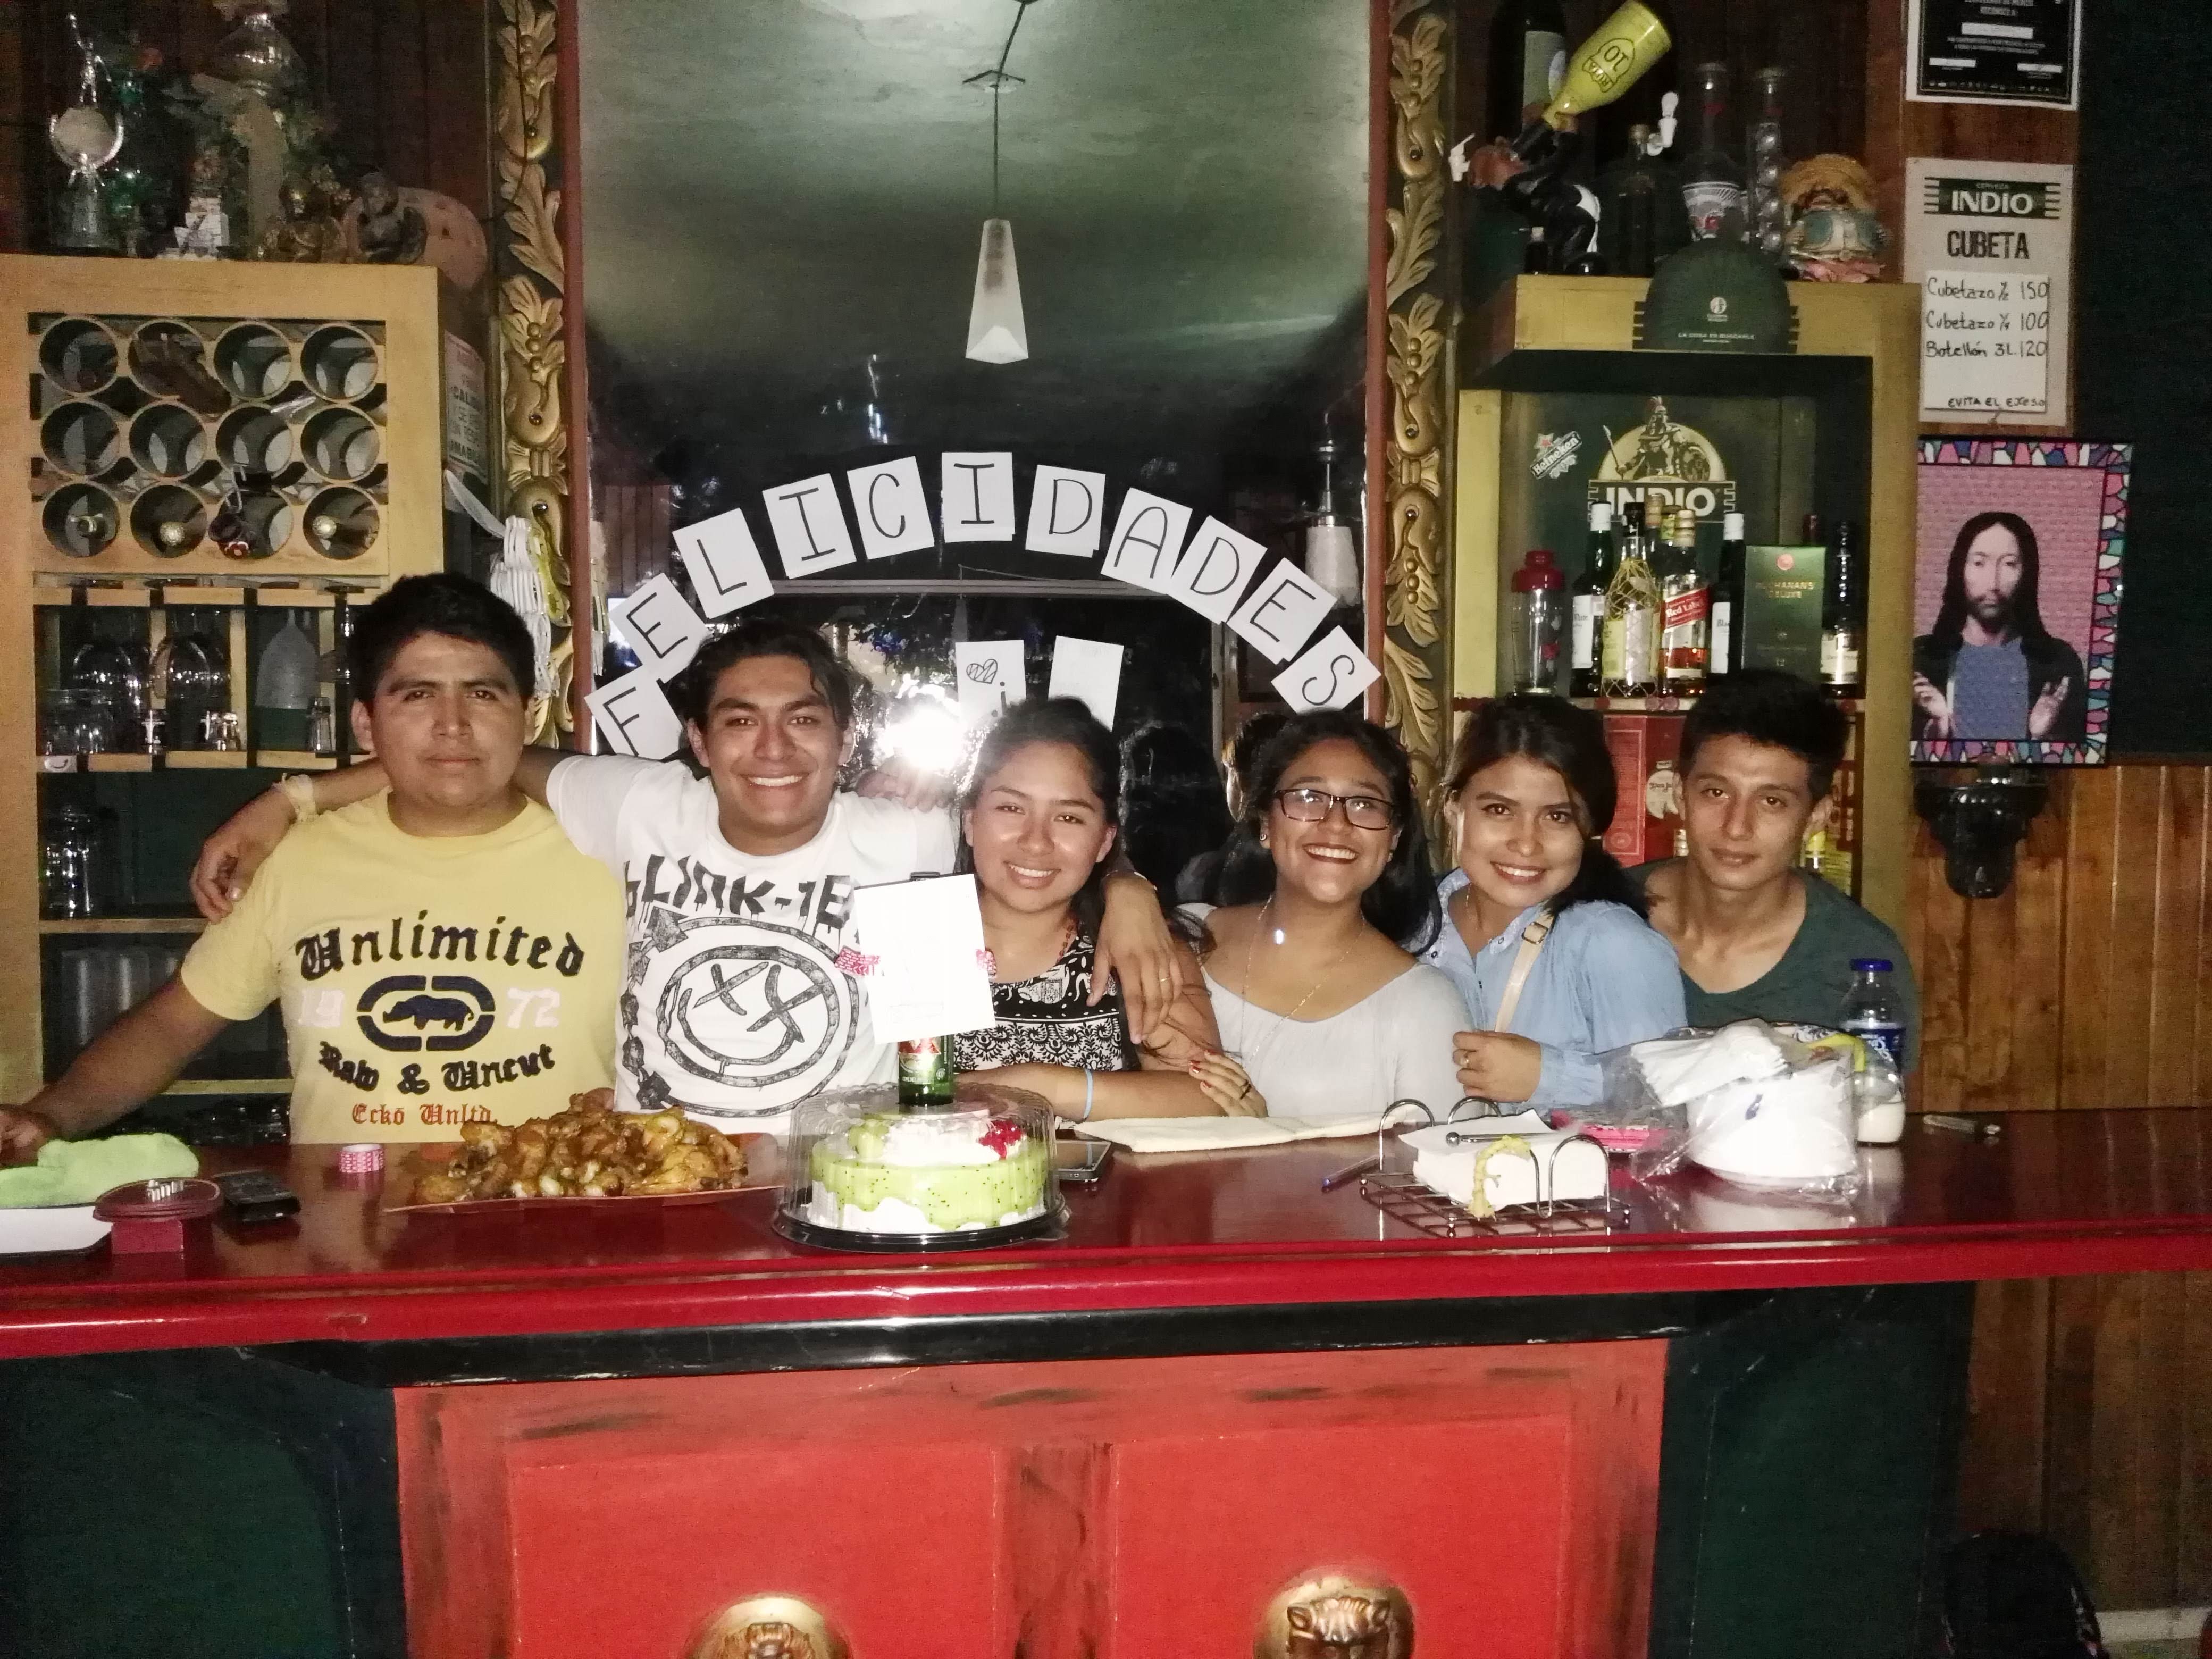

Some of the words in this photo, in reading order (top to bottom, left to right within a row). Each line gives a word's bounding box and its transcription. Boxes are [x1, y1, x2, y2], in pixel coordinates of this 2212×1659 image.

[1951, 190, 2033, 215] INDIO
[1947, 230, 2030, 259] CUBETA
[1927, 276, 1995, 299] Cubetazo
[2021, 281, 2048, 299] 150
[1926, 310, 1995, 330] Cubetazo
[2021, 312, 2048, 331] 100
[2020, 340, 2048, 358] 120
[1948, 397, 1981, 408] EVITA
[1985, 397, 1999, 406] EL
[1531, 437, 1579, 475] Heineken
[295, 910, 585, 980] Unlimited
[506, 987, 560, 1029] 72
[318, 1041, 380, 1091] Raw
[397, 1063, 430, 1095] &
[441, 1044, 556, 1092] Uncut
